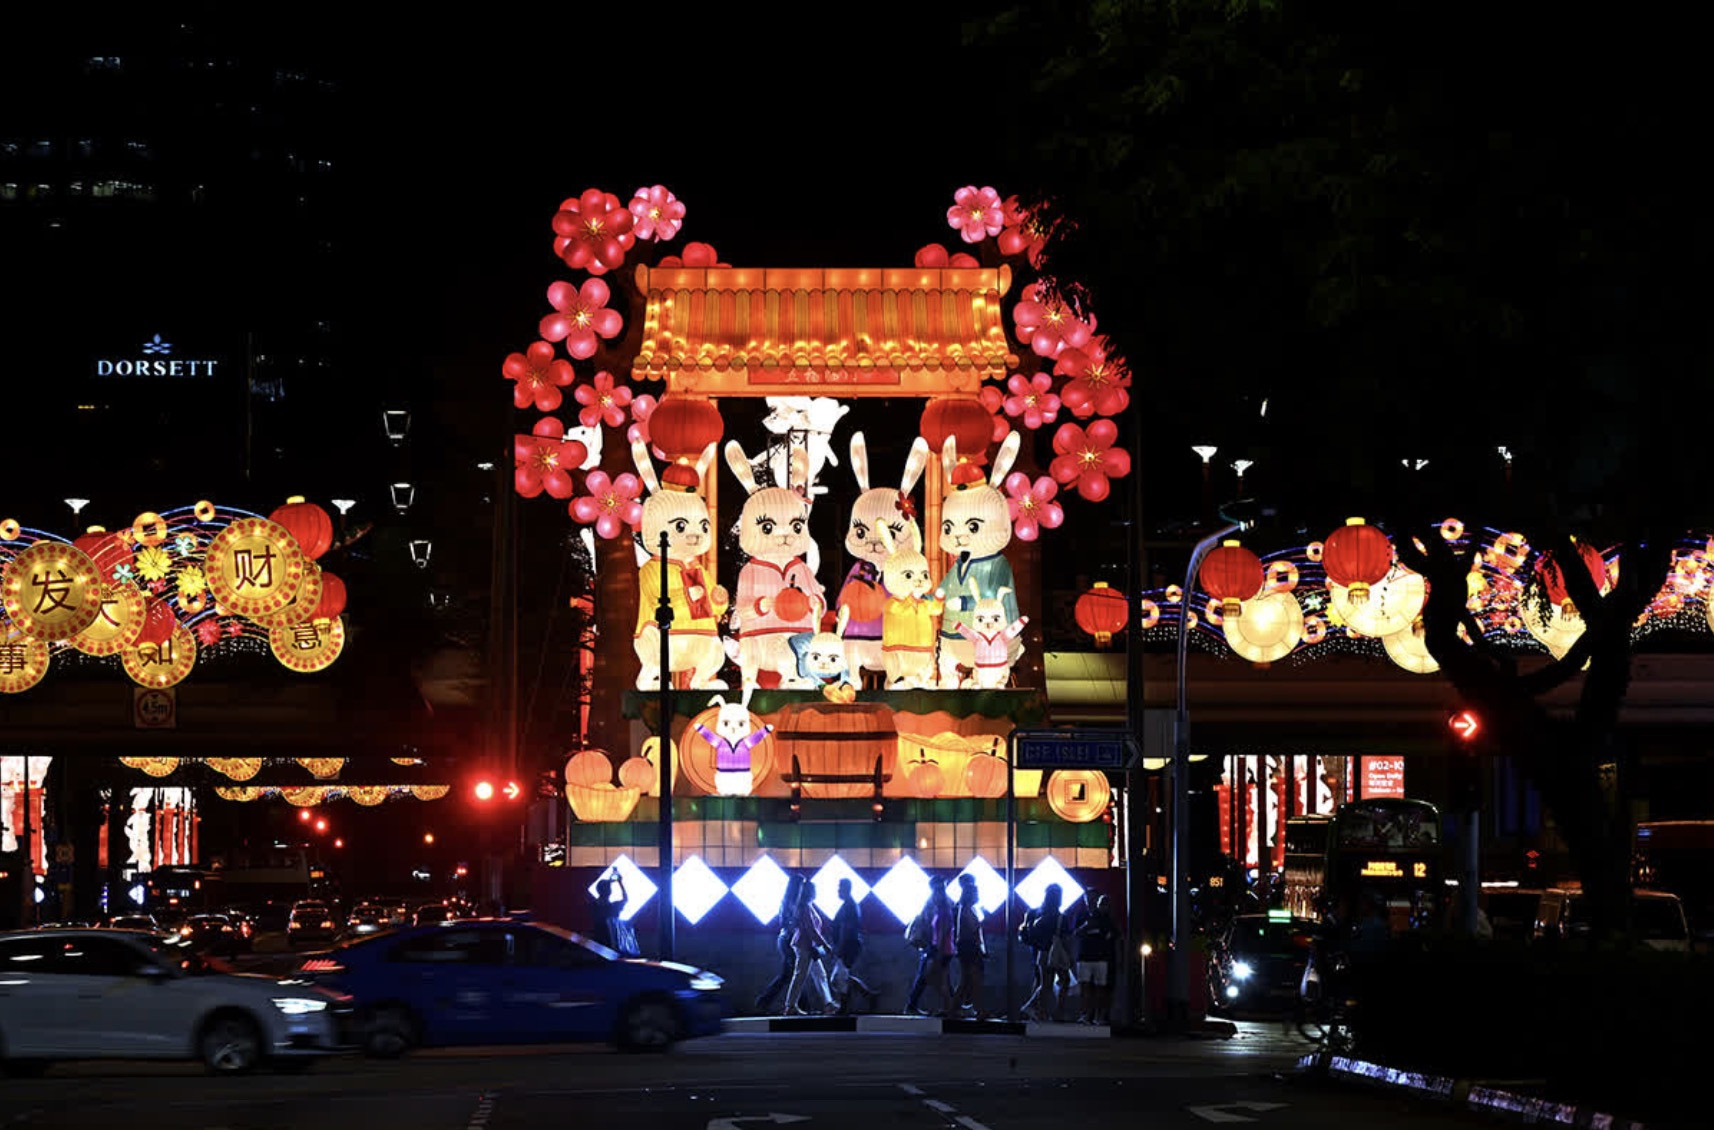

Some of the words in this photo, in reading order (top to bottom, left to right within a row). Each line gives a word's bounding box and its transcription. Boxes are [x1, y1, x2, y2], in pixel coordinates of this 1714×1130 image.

[97, 359, 219, 376] DORSETT
[233, 545, 277, 590] 财
[31, 569, 77, 615] 发
[1413, 863, 1427, 877] 12
[1209, 876, 1224, 888] 851
